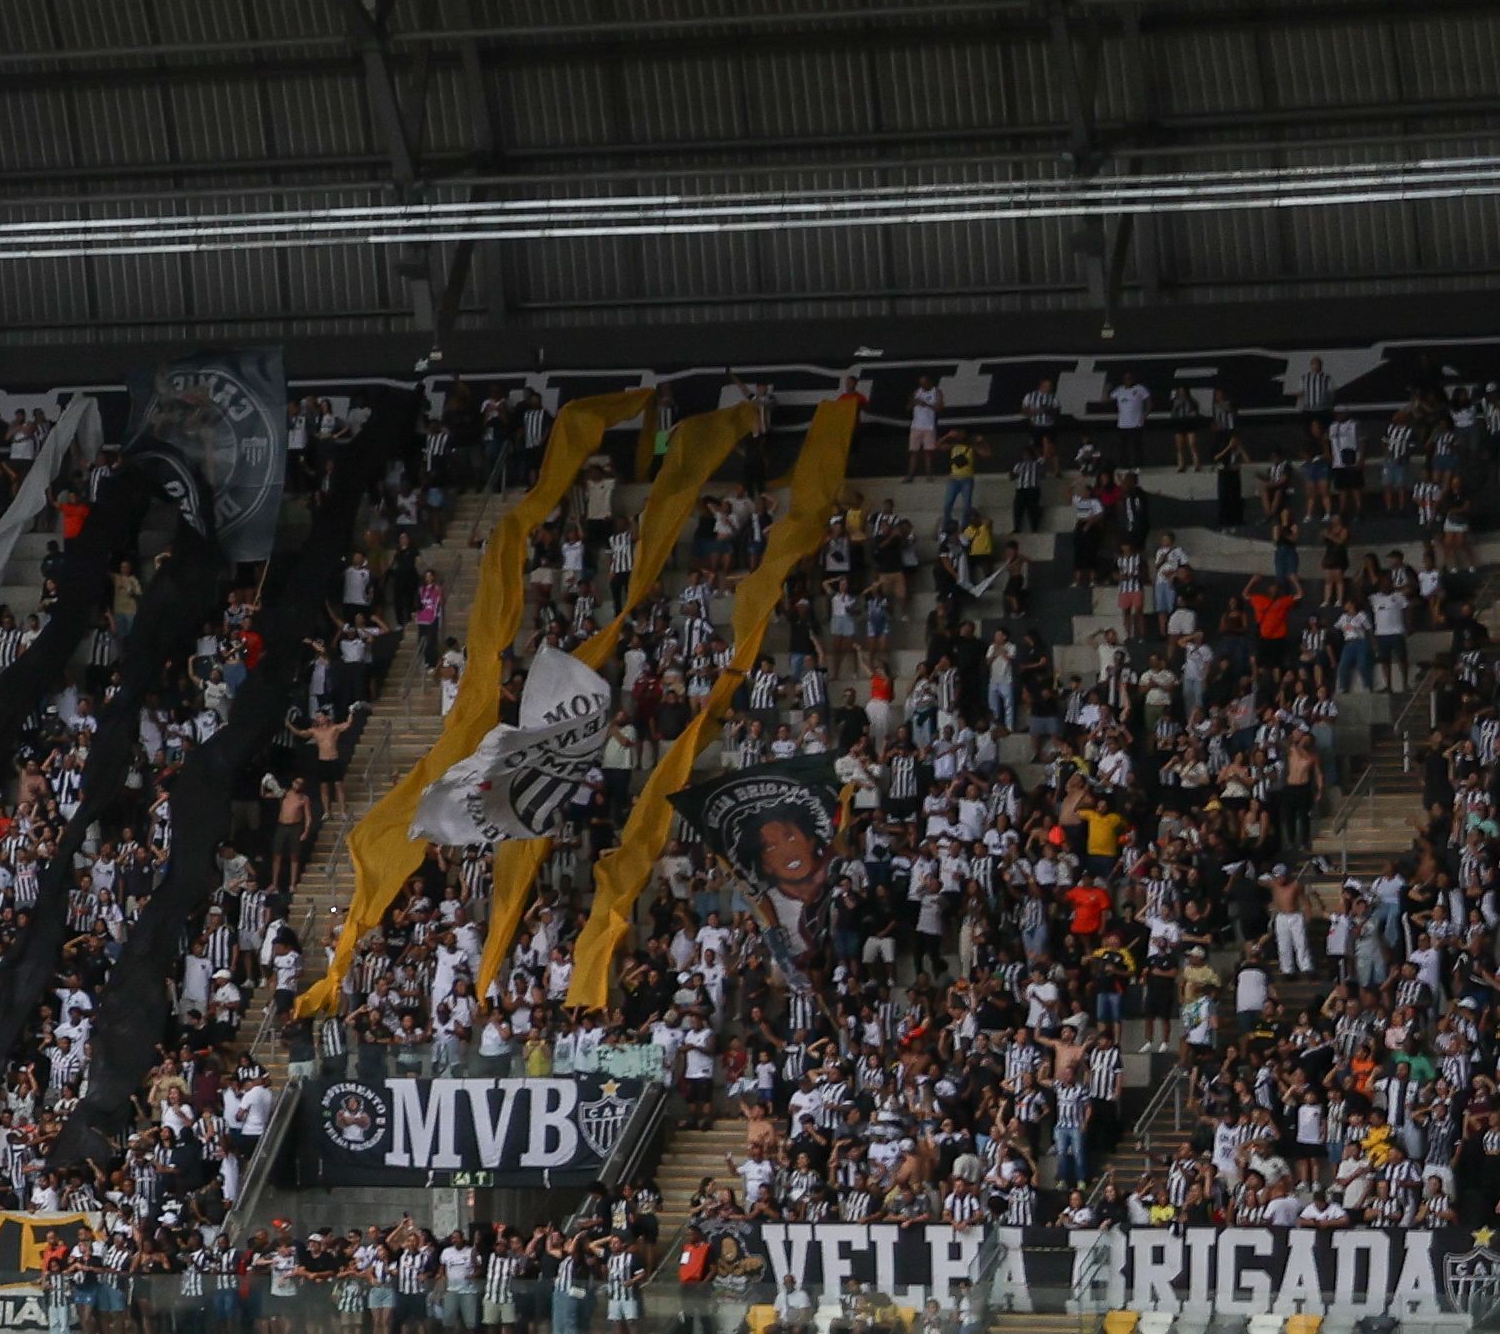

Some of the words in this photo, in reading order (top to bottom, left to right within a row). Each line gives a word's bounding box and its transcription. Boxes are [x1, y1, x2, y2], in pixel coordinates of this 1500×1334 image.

[384, 1078, 579, 1169] MVB
[761, 1228, 1035, 1315] VELHA
[1067, 1227, 1440, 1317] BRIGADA
